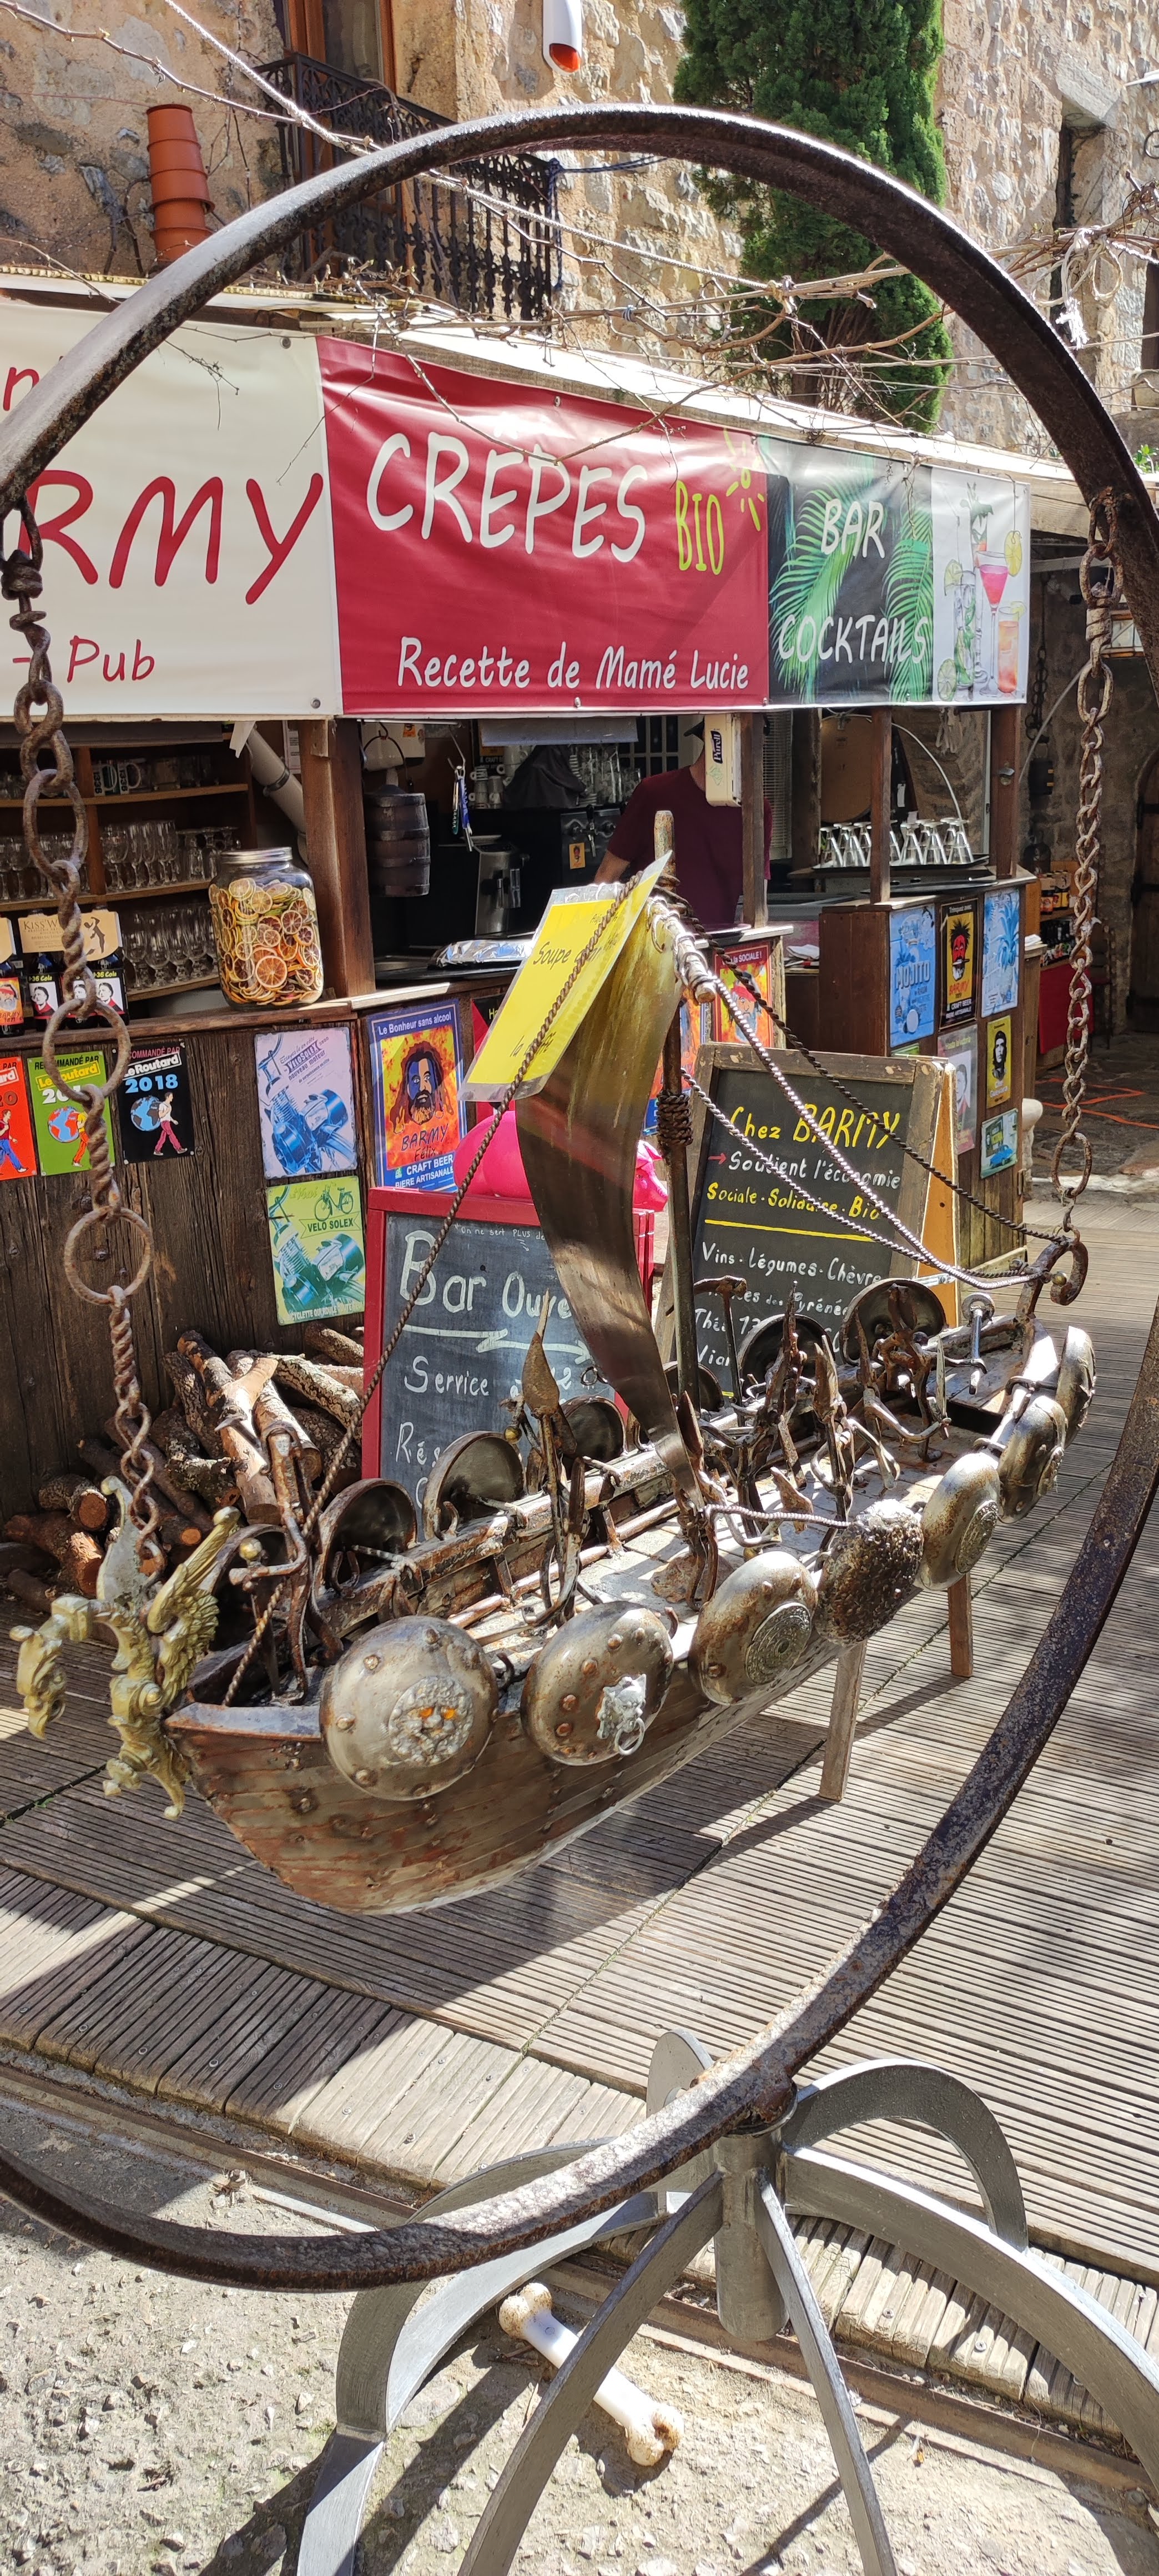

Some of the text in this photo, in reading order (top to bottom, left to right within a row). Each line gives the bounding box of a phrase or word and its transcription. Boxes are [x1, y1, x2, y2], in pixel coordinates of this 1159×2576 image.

[676, 480, 724, 575] BIO
[820, 499, 885, 559] BAR
[778, 615, 929, 664] COCKTAILS
[67, 635, 155, 682] Pub
[397, 636, 749, 690] Recette de Mamé Lucie
[24, 919, 57, 930] KISS'W
[533, 941, 571, 970] Soupe
[739, 951, 759, 962] SOCIALE
[896, 961, 930, 989] MOJITO
[378, 1012, 451, 1035] Le Bonheur sans alcool
[35, 1055, 83, 1070] REMMANDÉ
[61, 1063, 98, 1081] outard
[135, 1054, 178, 1074] Routard
[289, 1050, 325, 1080] nouveau moteur
[125, 1074, 178, 1093] 2018
[401, 1123, 449, 1151] BARMY
[729, 1103, 900, 1149] Chez BARMY
[406, 1154, 453, 1175] CRAFT BEER
[415, 1145, 435, 1161] Félix
[395, 1166, 453, 1188] BIERE ARTISANALE
[707, 1182, 757, 1204] Sociale
[849, 1195, 879, 1220] Bio
[308, 1218, 354, 1232] VELO SOLEX
[513, 1229, 530, 1237] PLUS
[702, 1241, 735, 1264] Vins
[749, 1247, 817, 1276] Légumes
[399, 1230, 572, 1319] Bar Ouve
[766, 1290, 783, 1306] des
[405, 1355, 489, 1396] Service
